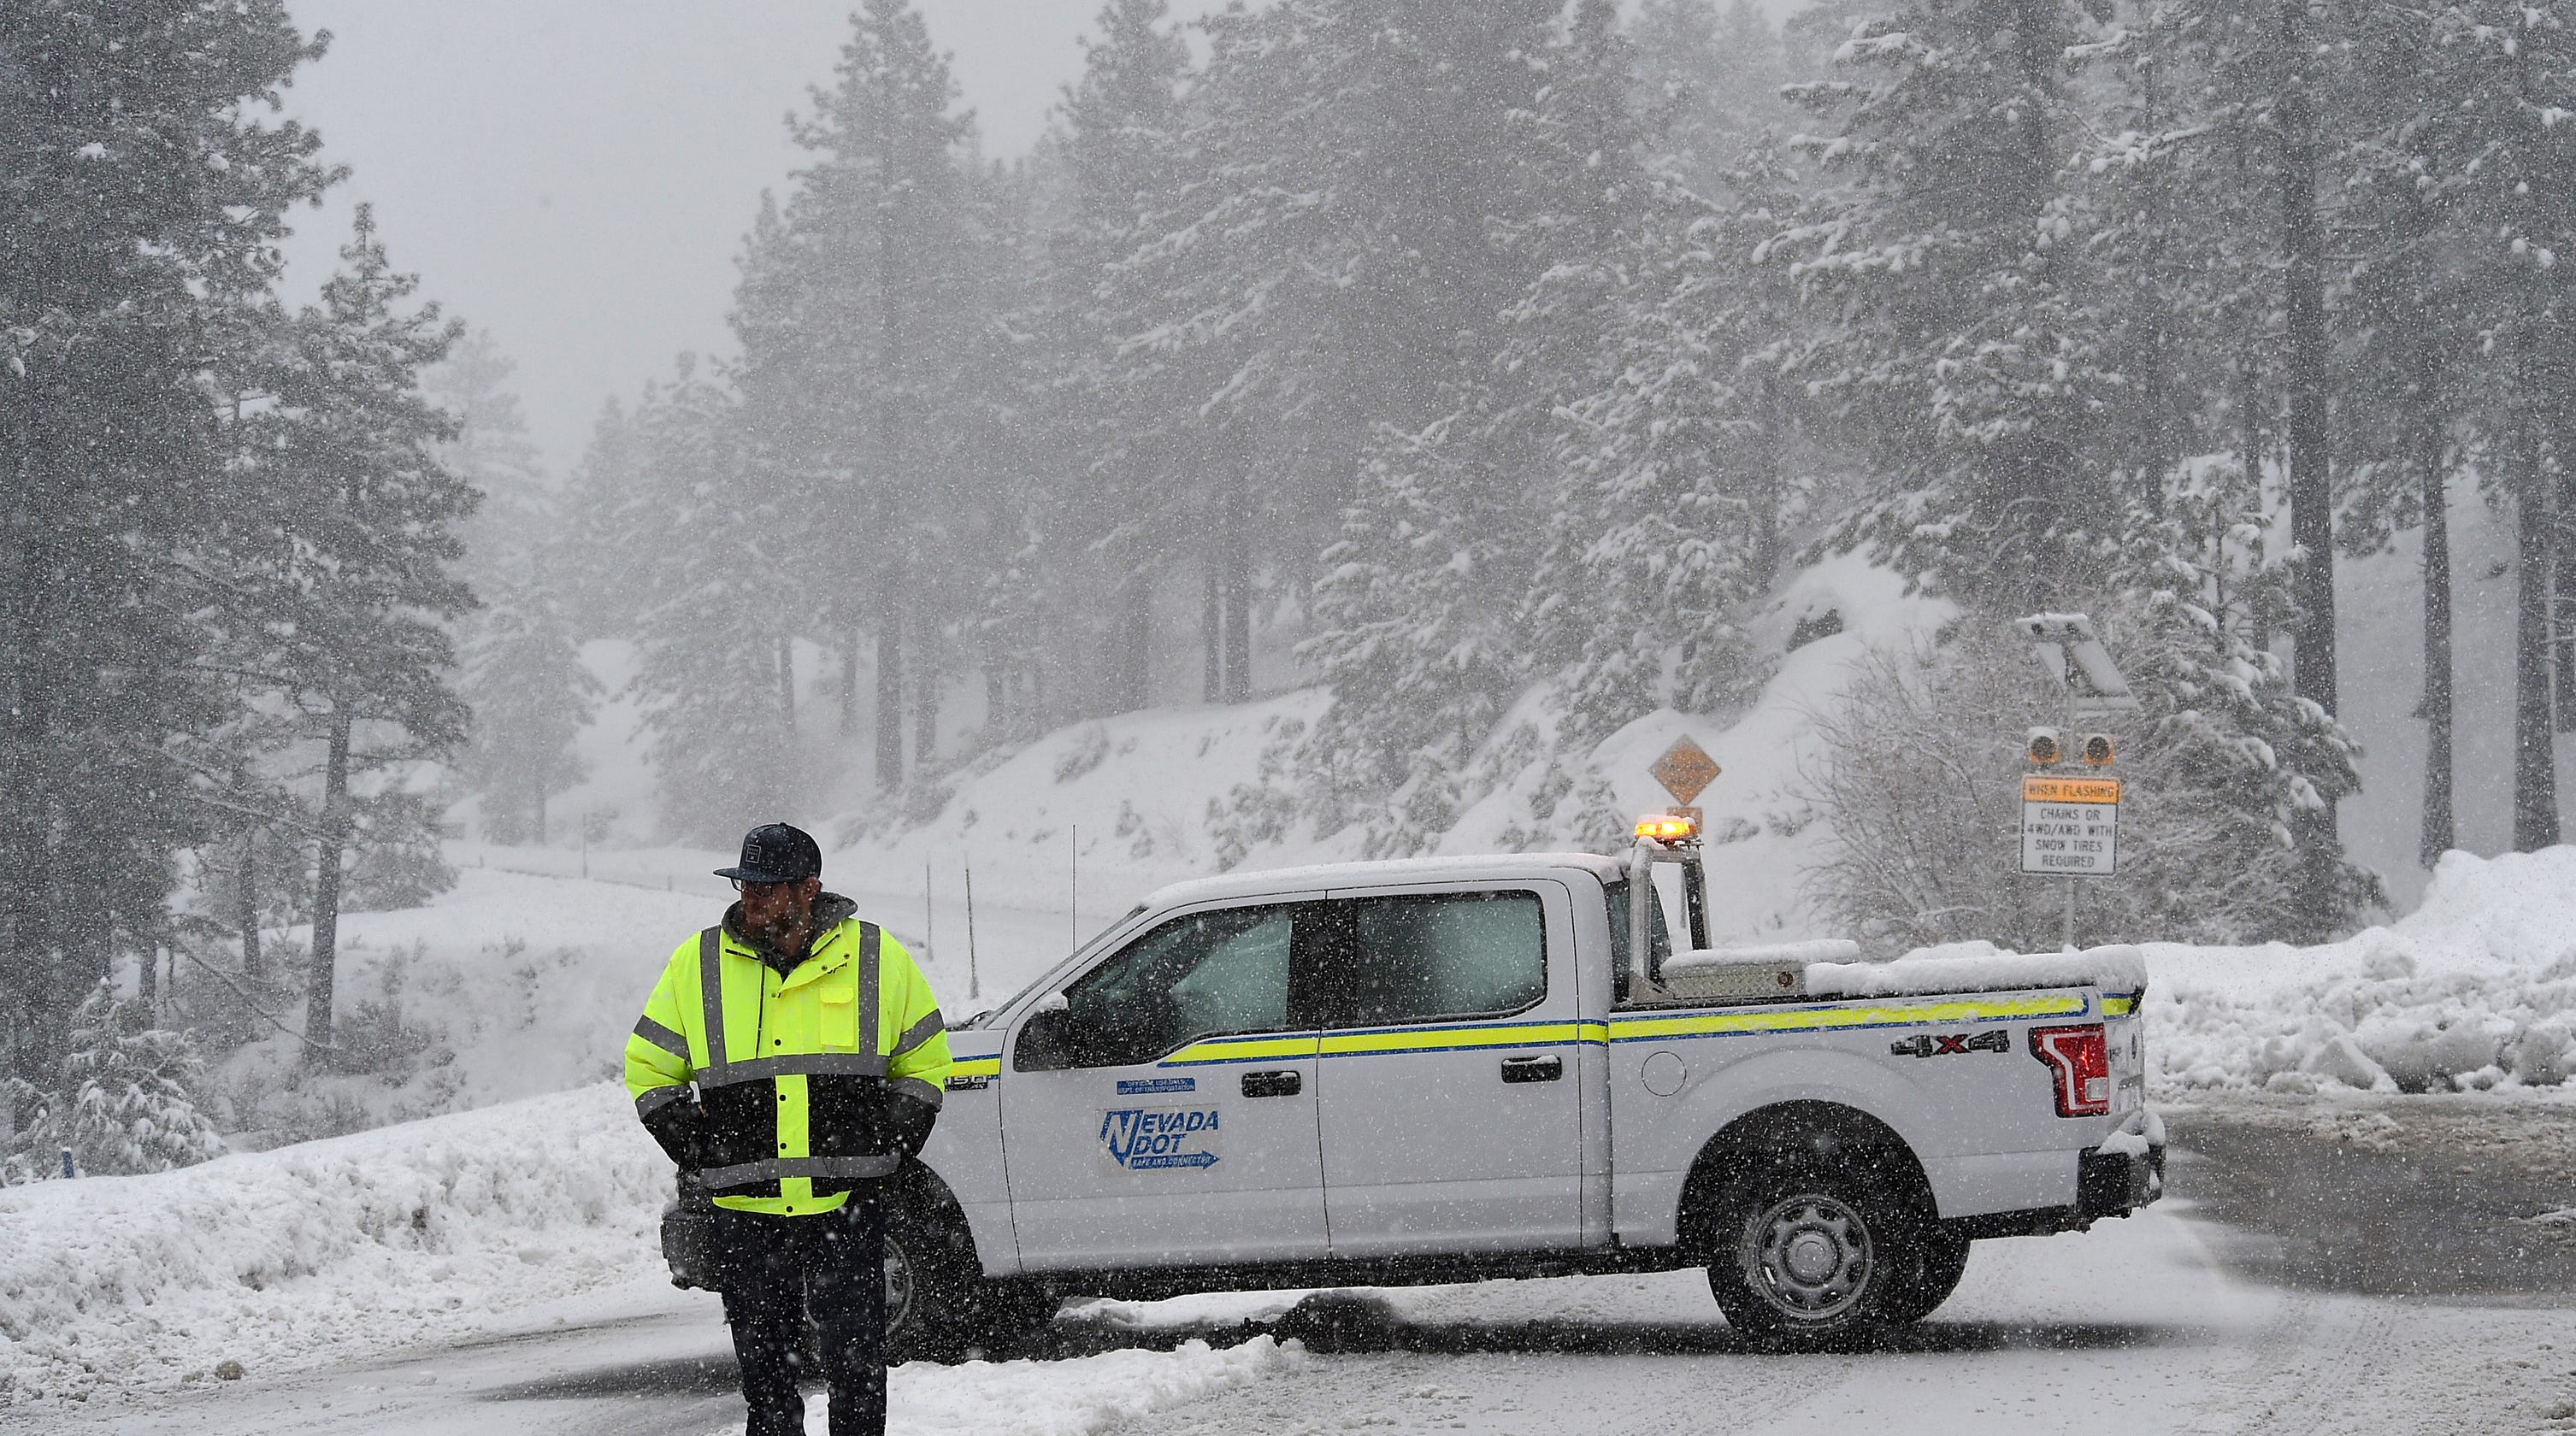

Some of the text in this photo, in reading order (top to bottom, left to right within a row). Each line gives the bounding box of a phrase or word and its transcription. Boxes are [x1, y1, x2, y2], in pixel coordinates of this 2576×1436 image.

[2029, 785, 2114, 797] WHEN FLASHING
[2041, 808, 2101, 821] CHAINS OR
[2027, 823, 2113, 837] 4WD/AWD WITH
[2036, 839, 2103, 852] SNOW TIRES
[2042, 855, 2095, 868] REQUIRED
[1133, 1133, 1187, 1155] DOT
